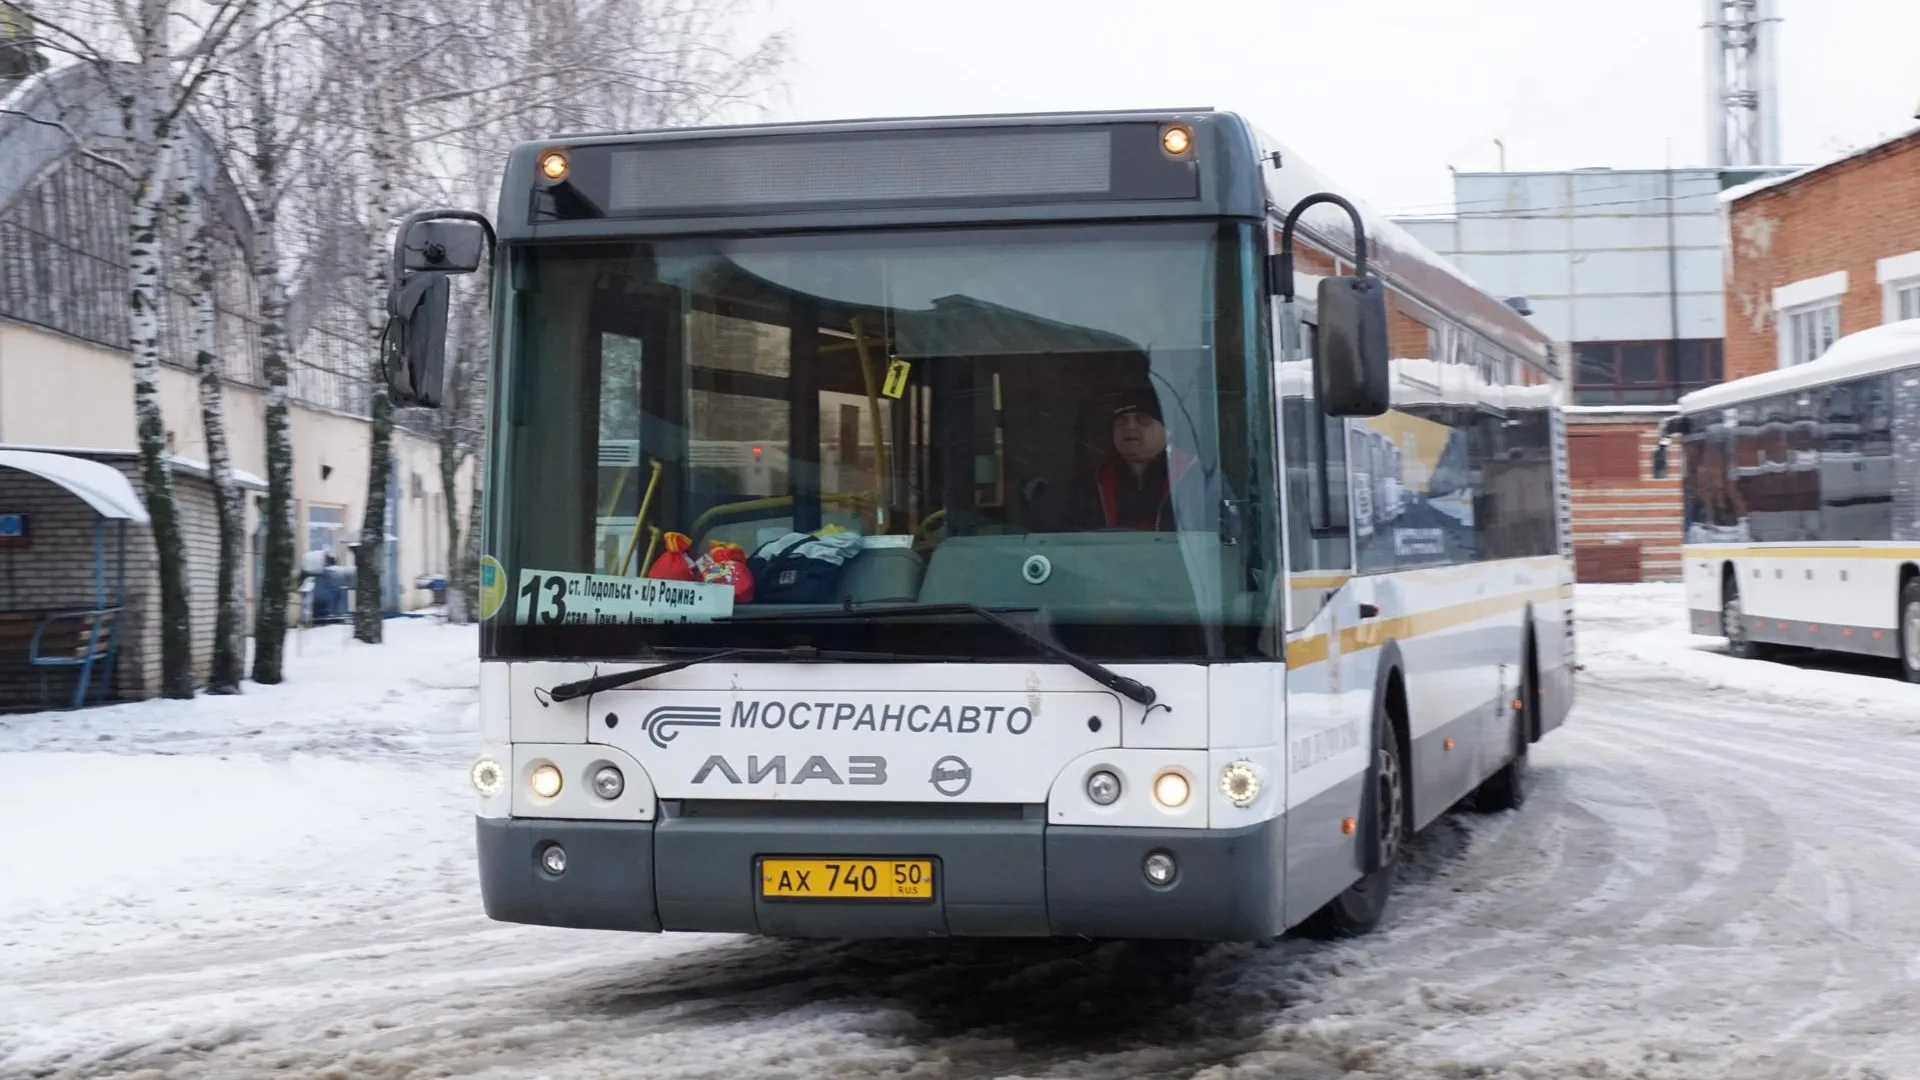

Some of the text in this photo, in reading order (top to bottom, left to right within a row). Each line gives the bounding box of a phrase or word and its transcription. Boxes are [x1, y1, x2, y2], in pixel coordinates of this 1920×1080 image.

[521, 575, 567, 625] 13
[568, 580, 580, 596] ст.
[584, 575, 632, 600] Подольск
[641, 580, 656, 607] к/р
[659, 581, 695, 607] Родина
[730, 701, 1032, 735] МОСТРАНСАВТО
[690, 755, 888, 785] ЛИАЗ
[825, 865, 877, 892] 740
[895, 864, 921, 884] 50
[898, 886, 918, 894] RUS
